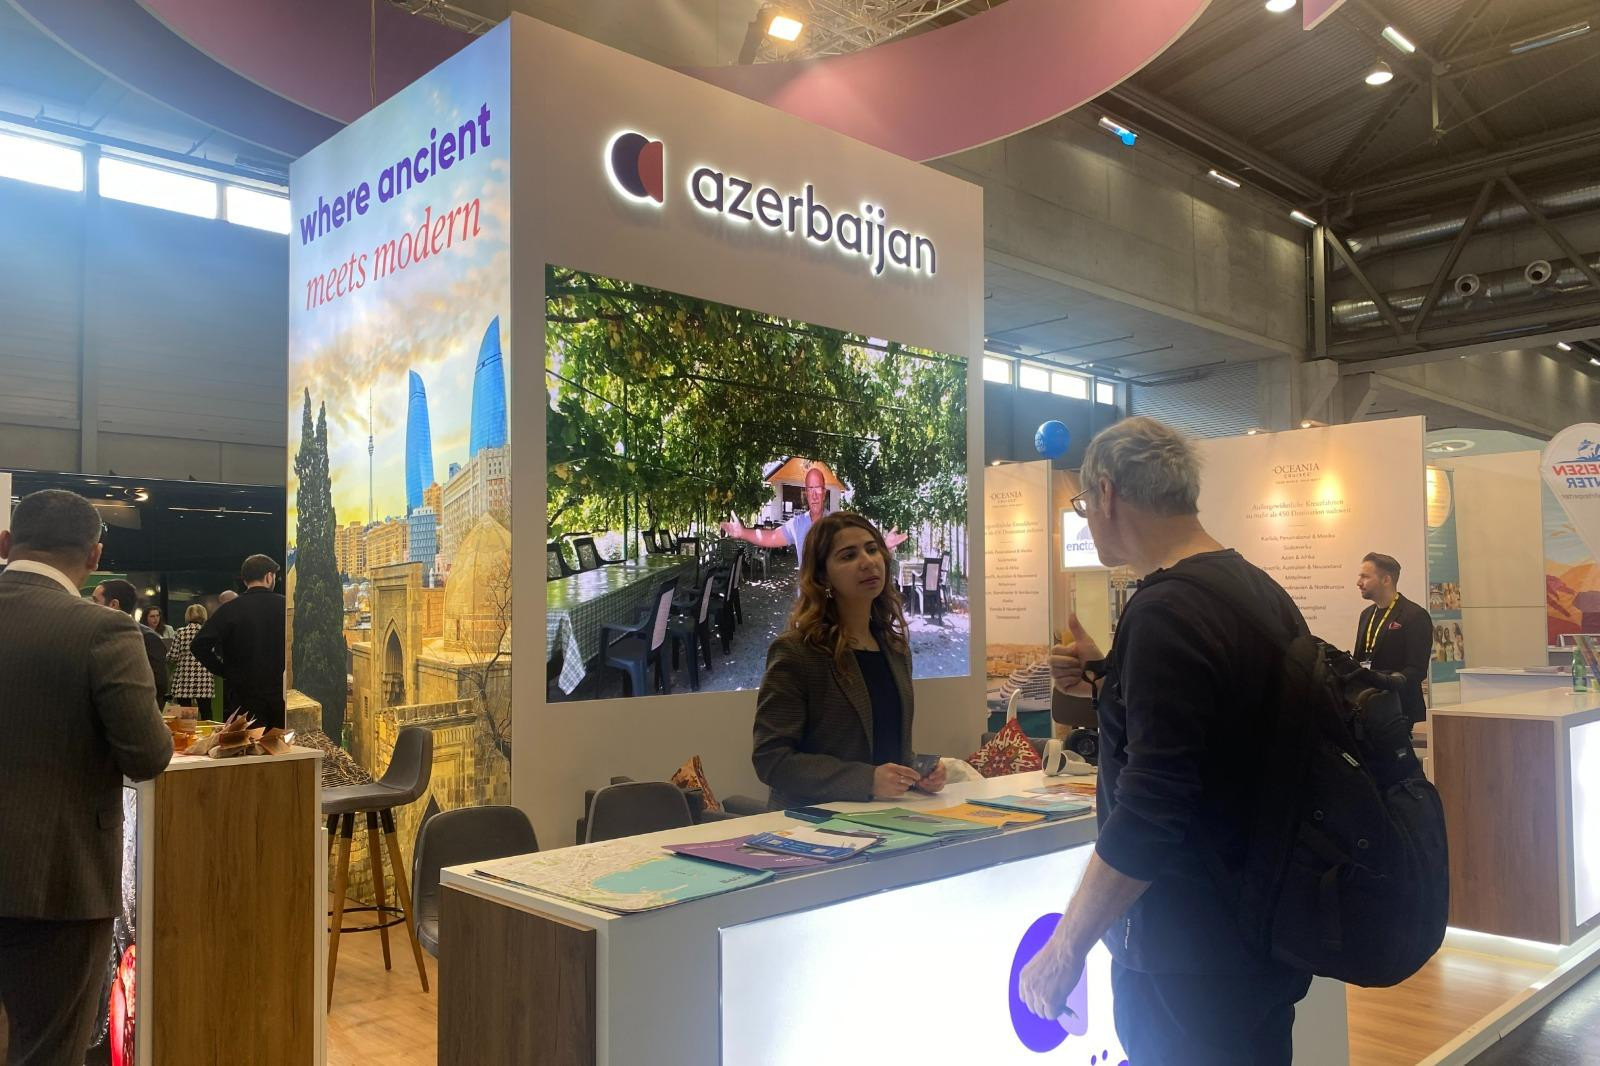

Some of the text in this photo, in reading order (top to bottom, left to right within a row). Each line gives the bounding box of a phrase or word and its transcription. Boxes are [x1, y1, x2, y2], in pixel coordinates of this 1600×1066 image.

[300, 101, 491, 246] where ancient
[690, 166, 937, 276] azerbaijan
[305, 198, 481, 311] meets modern
[991, 490, 1022, 500] OCEANIA
[1273, 463, 1320, 474] OCEANIA
[1066, 541, 1095, 552] encto
